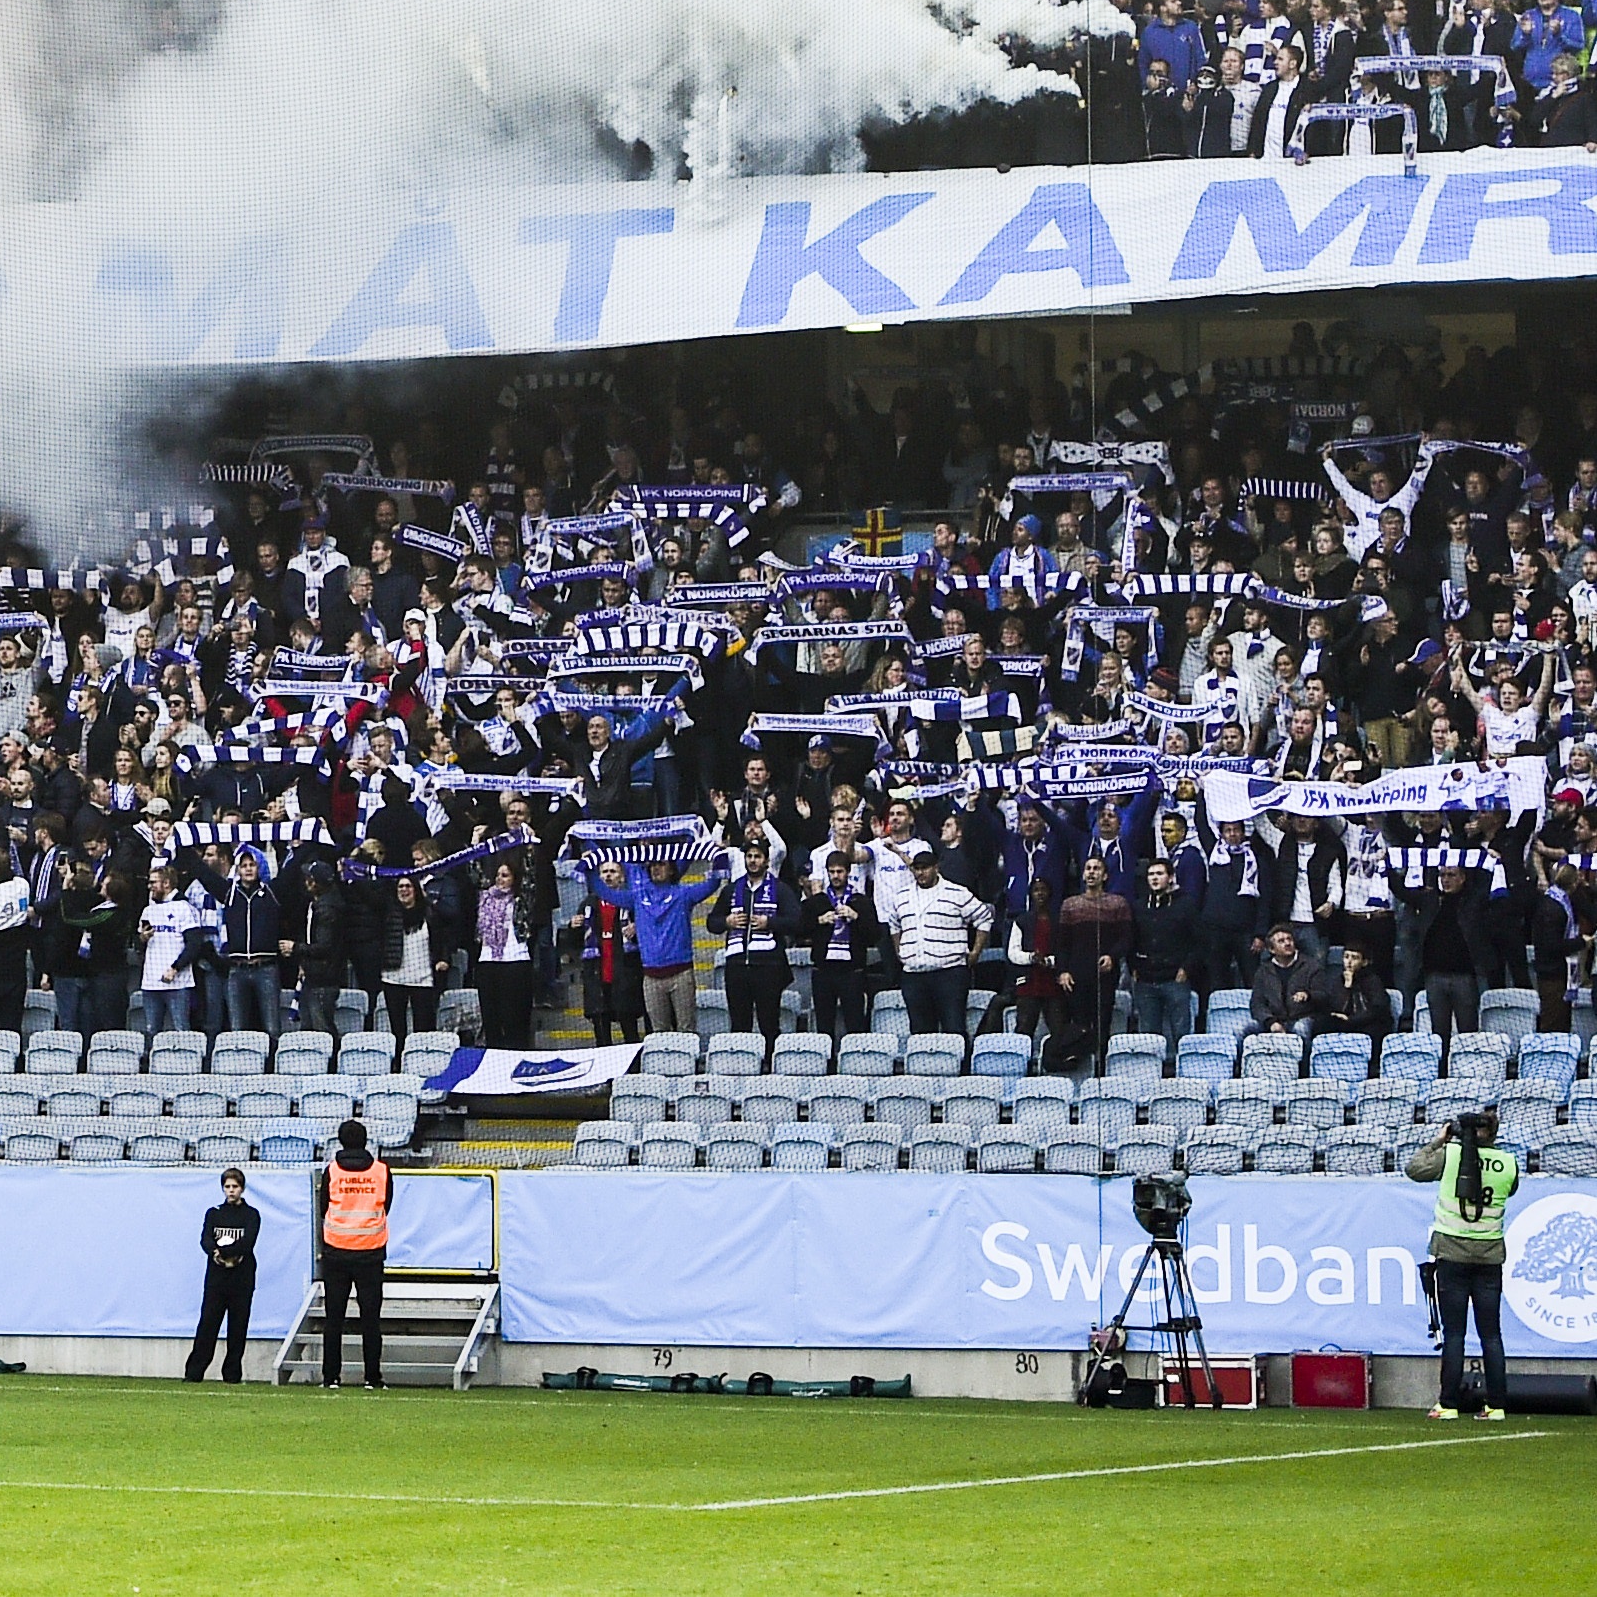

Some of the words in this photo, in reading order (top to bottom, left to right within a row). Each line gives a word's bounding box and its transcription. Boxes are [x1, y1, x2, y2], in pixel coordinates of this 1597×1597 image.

[641, 488, 661, 498] IFK
[864, 623, 904, 635] STAD
[1056, 748, 1077, 760] IFK
[980, 1220, 1418, 1306] Swedban
[1524, 1296, 1576, 1330] SINCE
[652, 1348, 674, 1369] 79
[1015, 1351, 1040, 1376] 80
